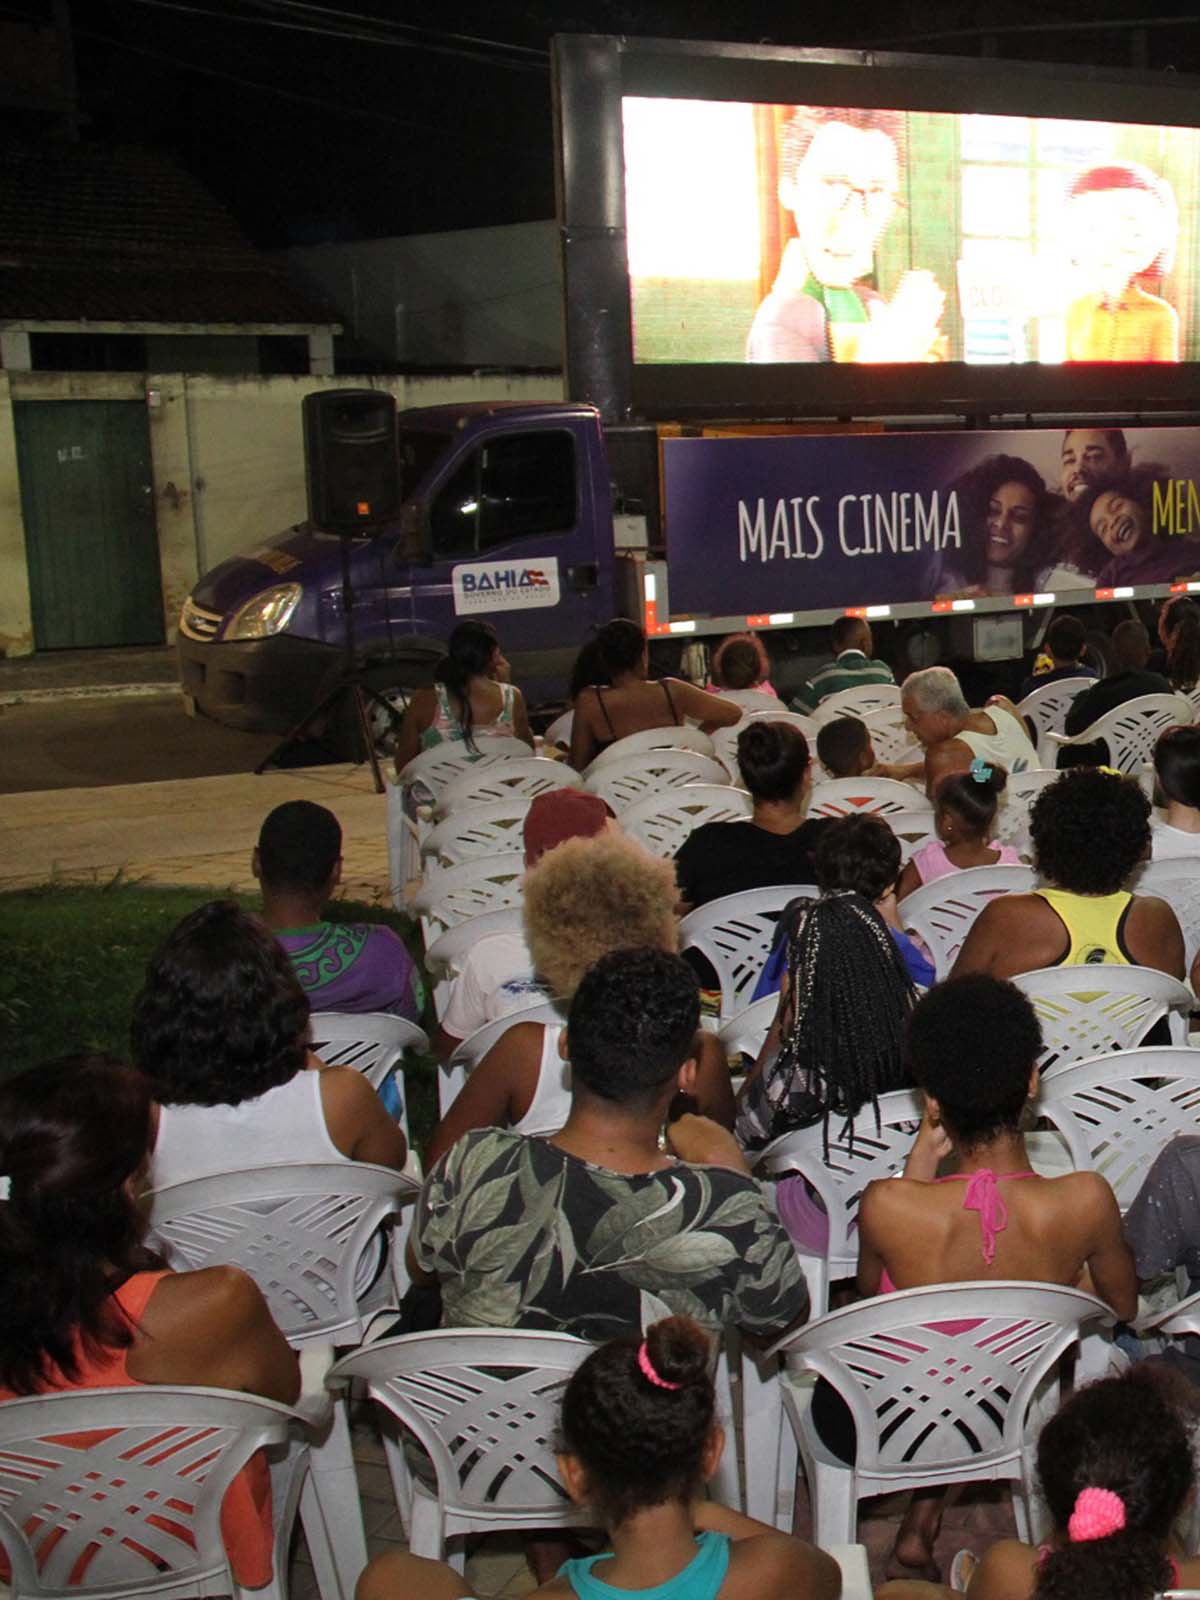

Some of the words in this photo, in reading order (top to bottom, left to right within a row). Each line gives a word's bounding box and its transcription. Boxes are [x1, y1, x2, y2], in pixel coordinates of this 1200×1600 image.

[738, 496, 824, 563] MAIS
[837, 490, 962, 557] CINEMA
[462, 568, 535, 592] BAHIA
